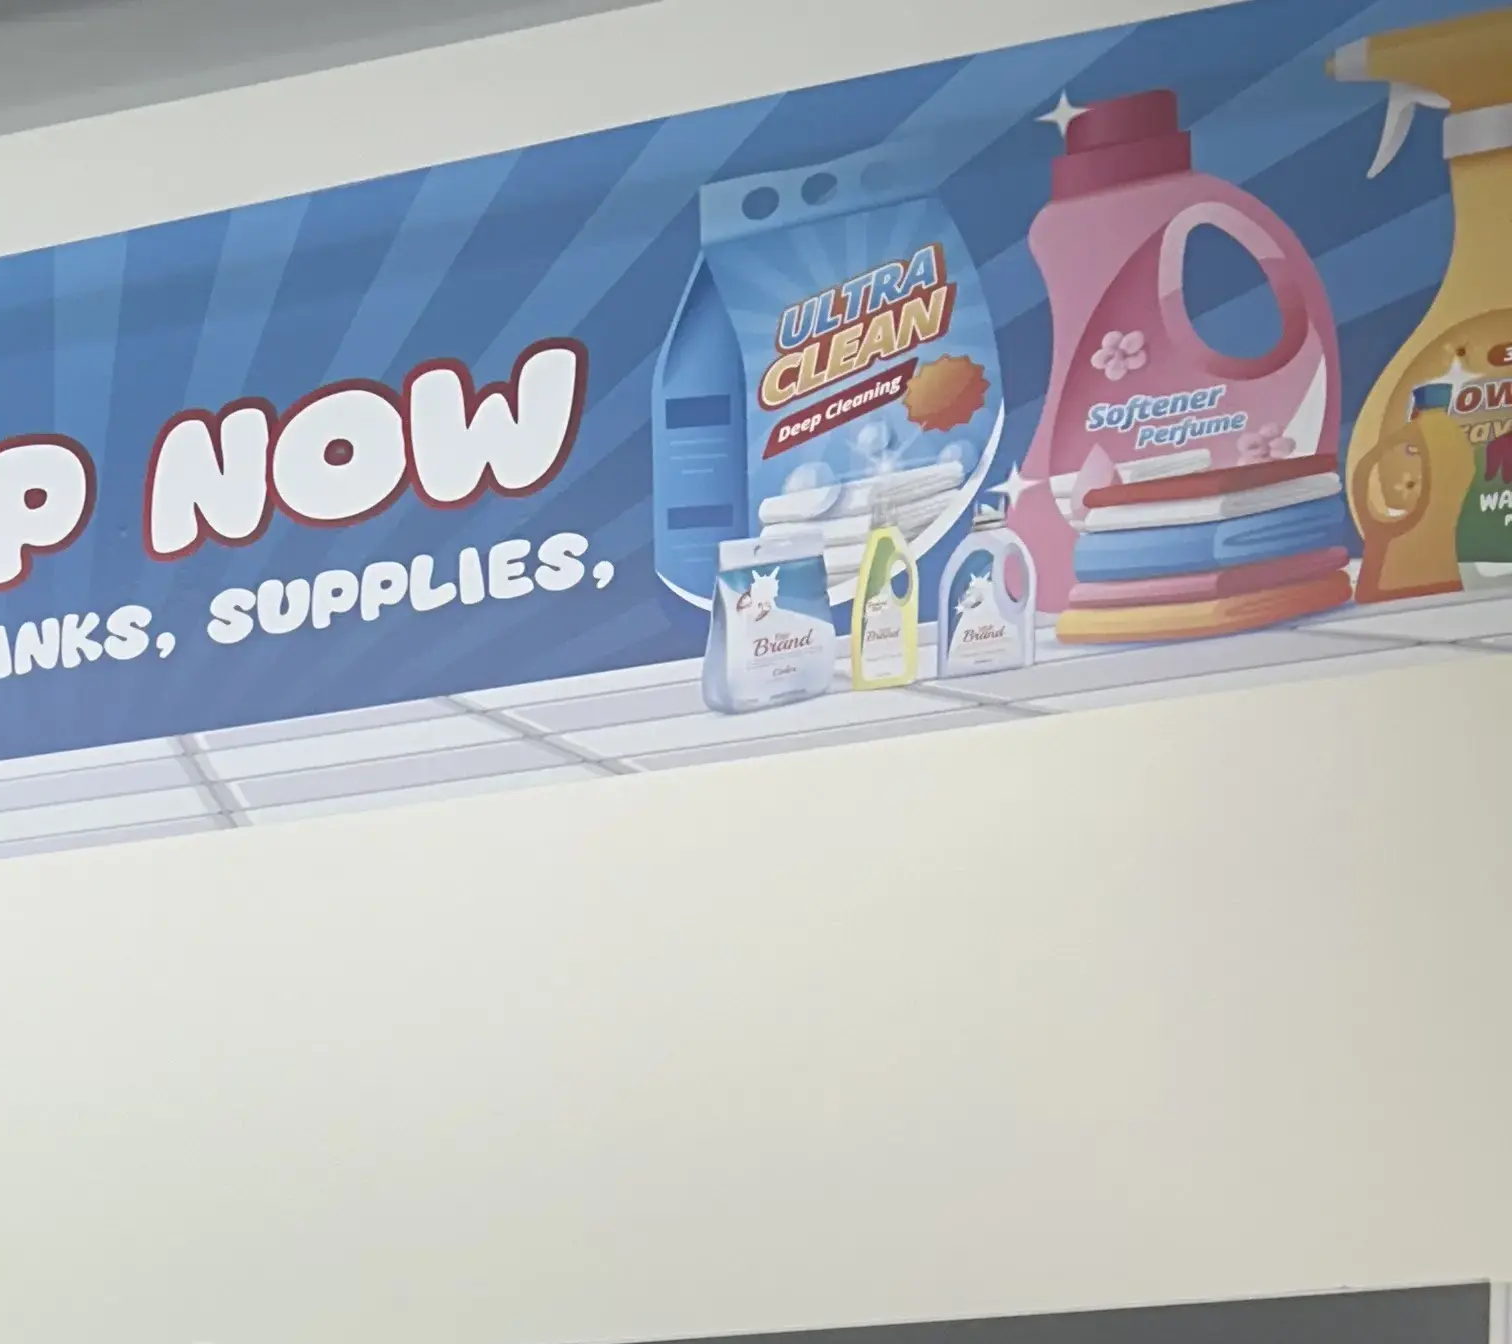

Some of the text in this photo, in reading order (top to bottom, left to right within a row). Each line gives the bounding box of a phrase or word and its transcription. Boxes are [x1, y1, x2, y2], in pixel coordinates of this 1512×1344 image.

[777, 245, 939, 350] ULTRA
[761, 287, 952, 409] CLEAN
[145, 341, 585, 559] NOW
[778, 376, 902, 441] Deep Cleaning
[1087, 386, 1225, 432] Softener
[1136, 411, 1247, 450] Perfume
[206, 532, 615, 643] SUPPLIES,
[753, 628, 813, 657] Brand
